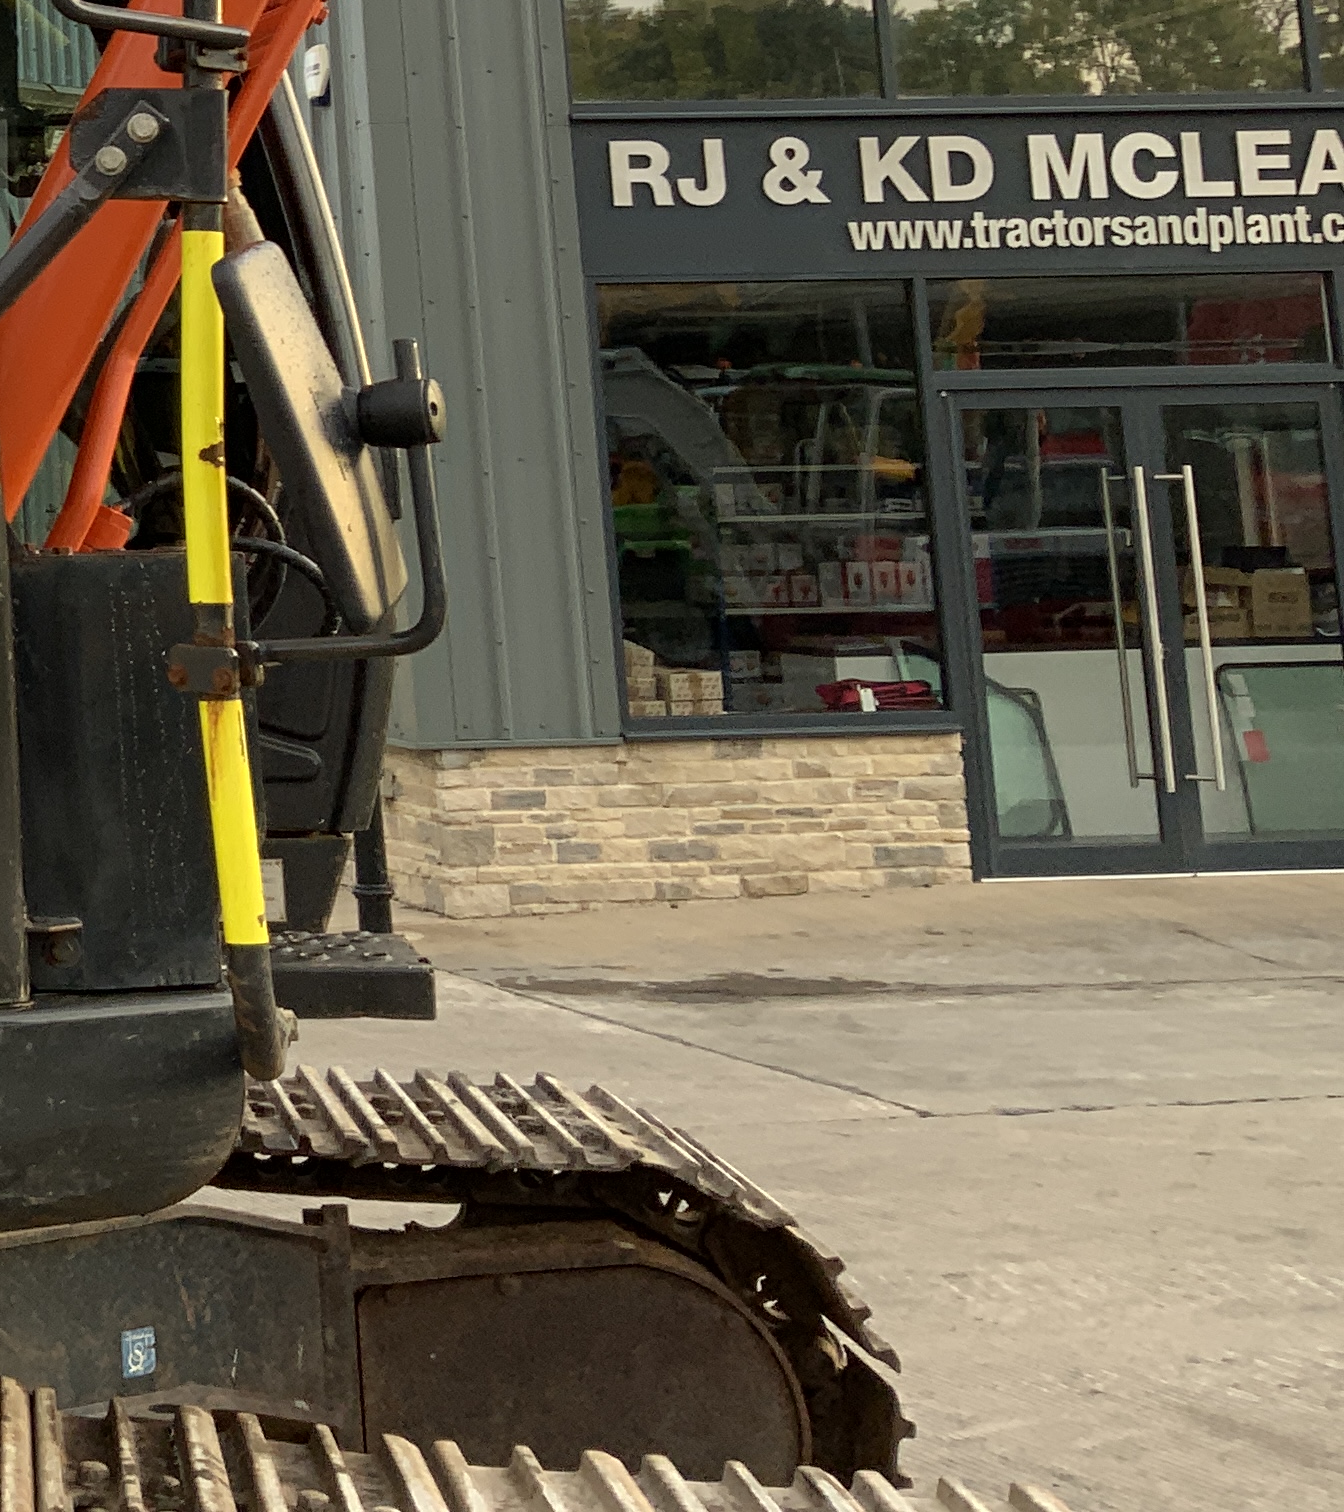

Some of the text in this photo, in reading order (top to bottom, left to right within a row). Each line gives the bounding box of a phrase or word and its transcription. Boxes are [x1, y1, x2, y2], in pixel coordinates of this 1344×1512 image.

[608, 129, 1344, 207] RJ & KD MCLEA
[848, 205, 1344, 252] www.tractorsandplant.c
